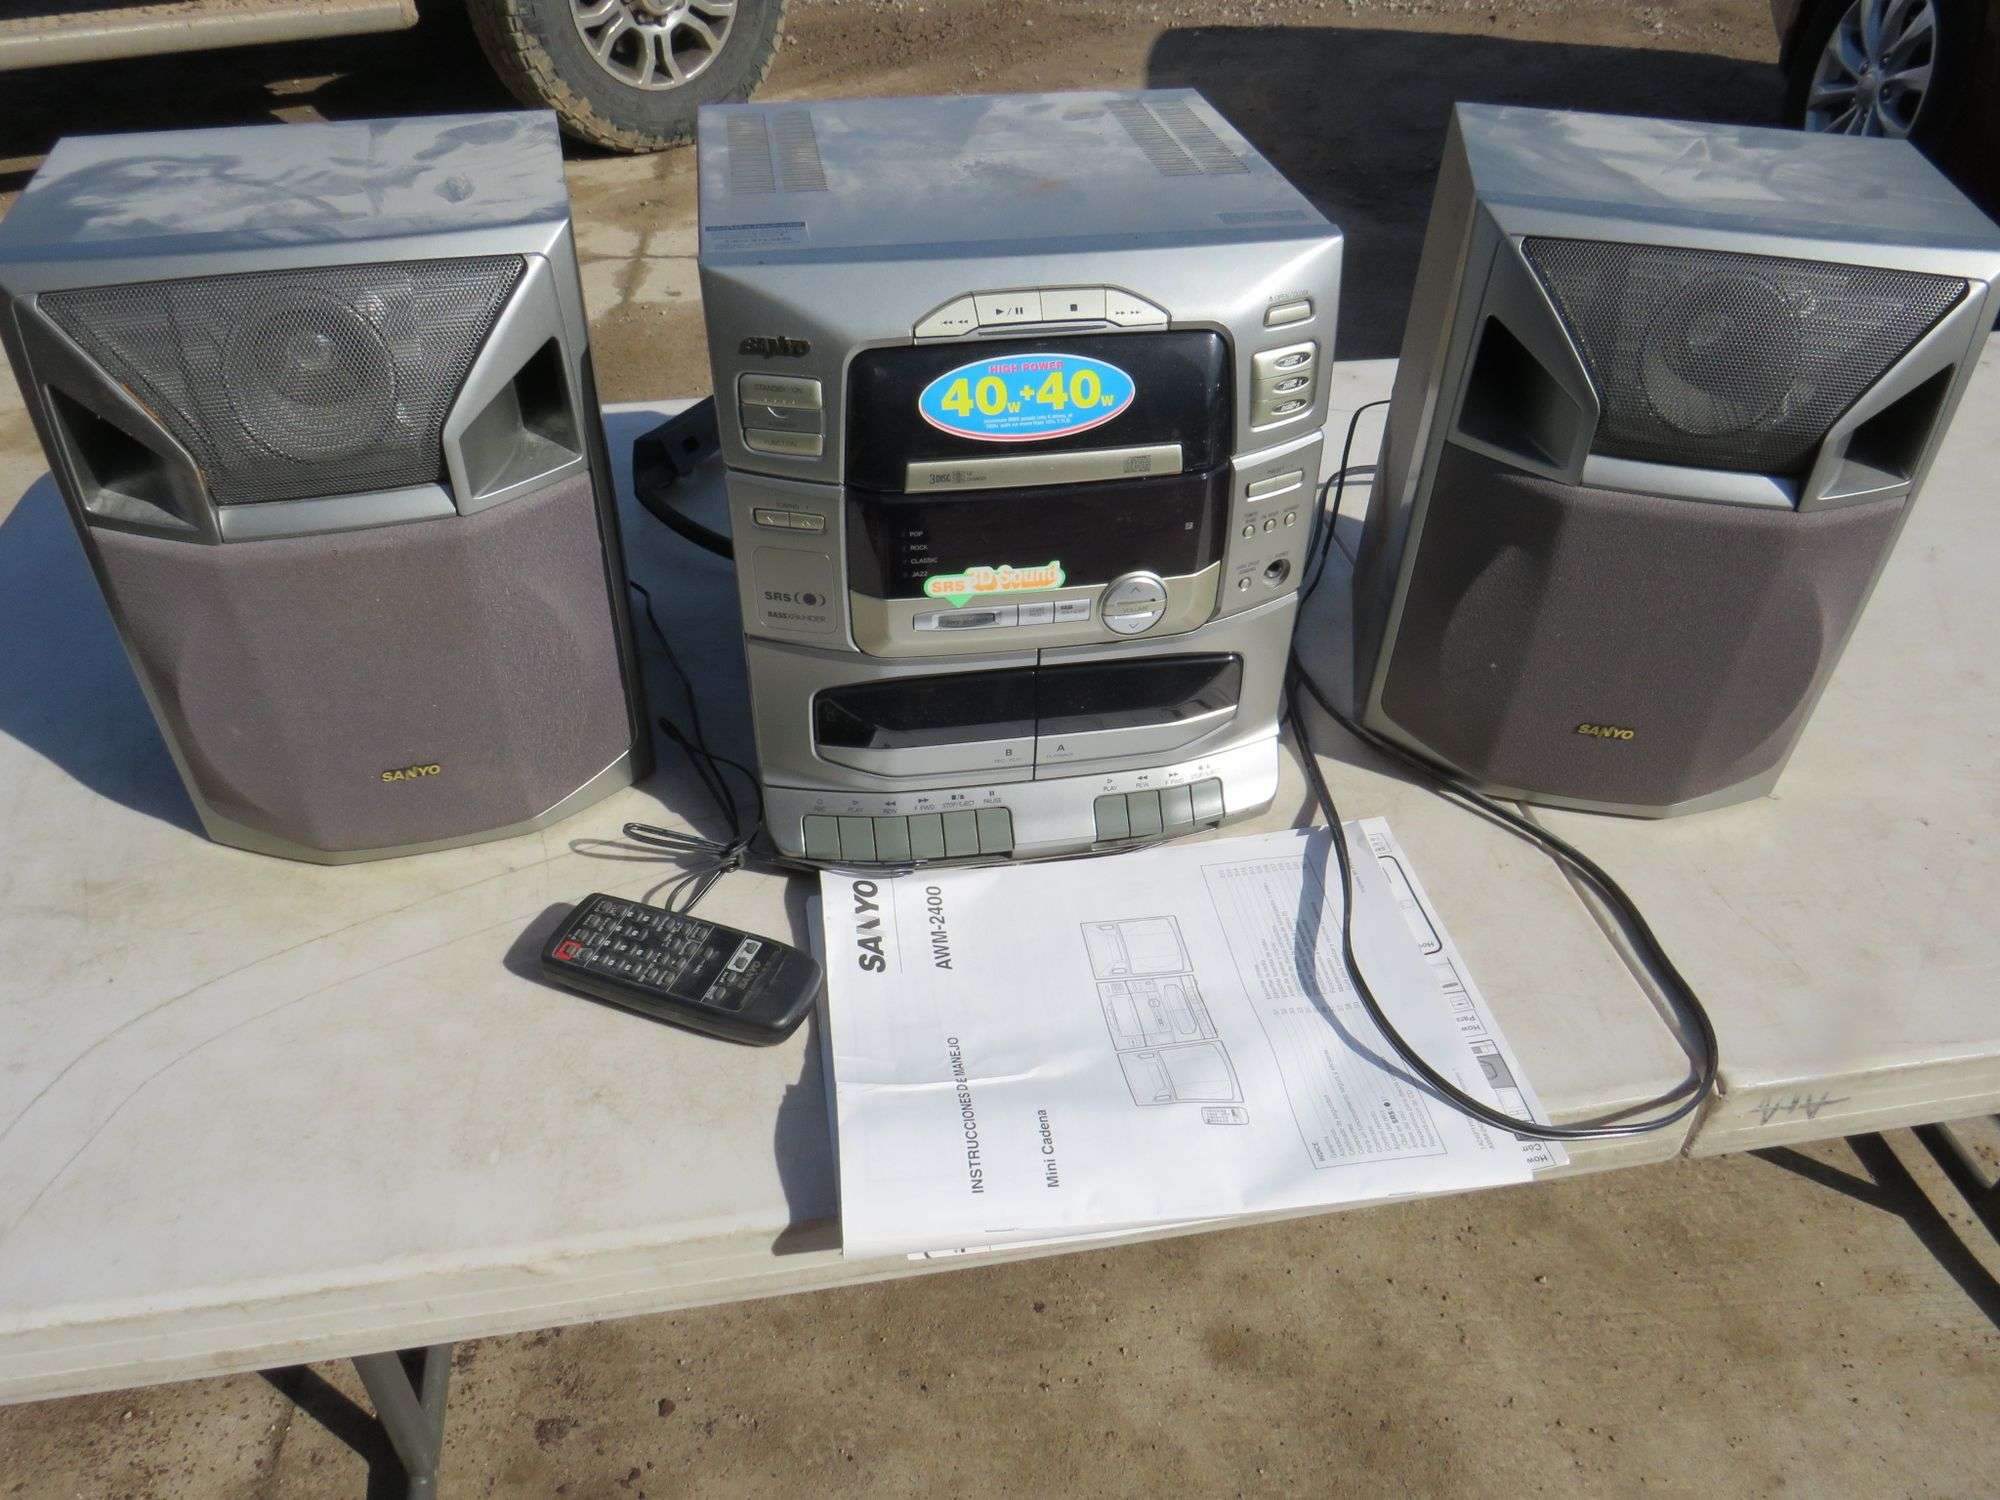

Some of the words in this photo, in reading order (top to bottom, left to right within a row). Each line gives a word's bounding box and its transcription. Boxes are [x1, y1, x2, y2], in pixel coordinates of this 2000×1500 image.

[988, 364, 1018, 374] HIGH
[1021, 360, 1064, 373] POWER
[911, 570, 929, 578] JAZZ
[931, 580, 966, 593] SRS
[1000, 564, 1059, 590] Sound
[1577, 723, 1634, 740] SANYO
[1005, 748, 1013, 757] B
[1056, 744, 1065, 752] A
[381, 764, 441, 782] SANYO
[852, 879, 886, 974] SANYO
[926, 886, 953, 970] AWM-2400
[947, 1037, 966, 1076] MANEJO
[955, 1077, 969, 1091] DE
[958, 1092, 984, 1194] INSTRUCCIONES
[1038, 1109, 1055, 1155] Cadena
[1044, 1158, 1060, 1188] Mini
